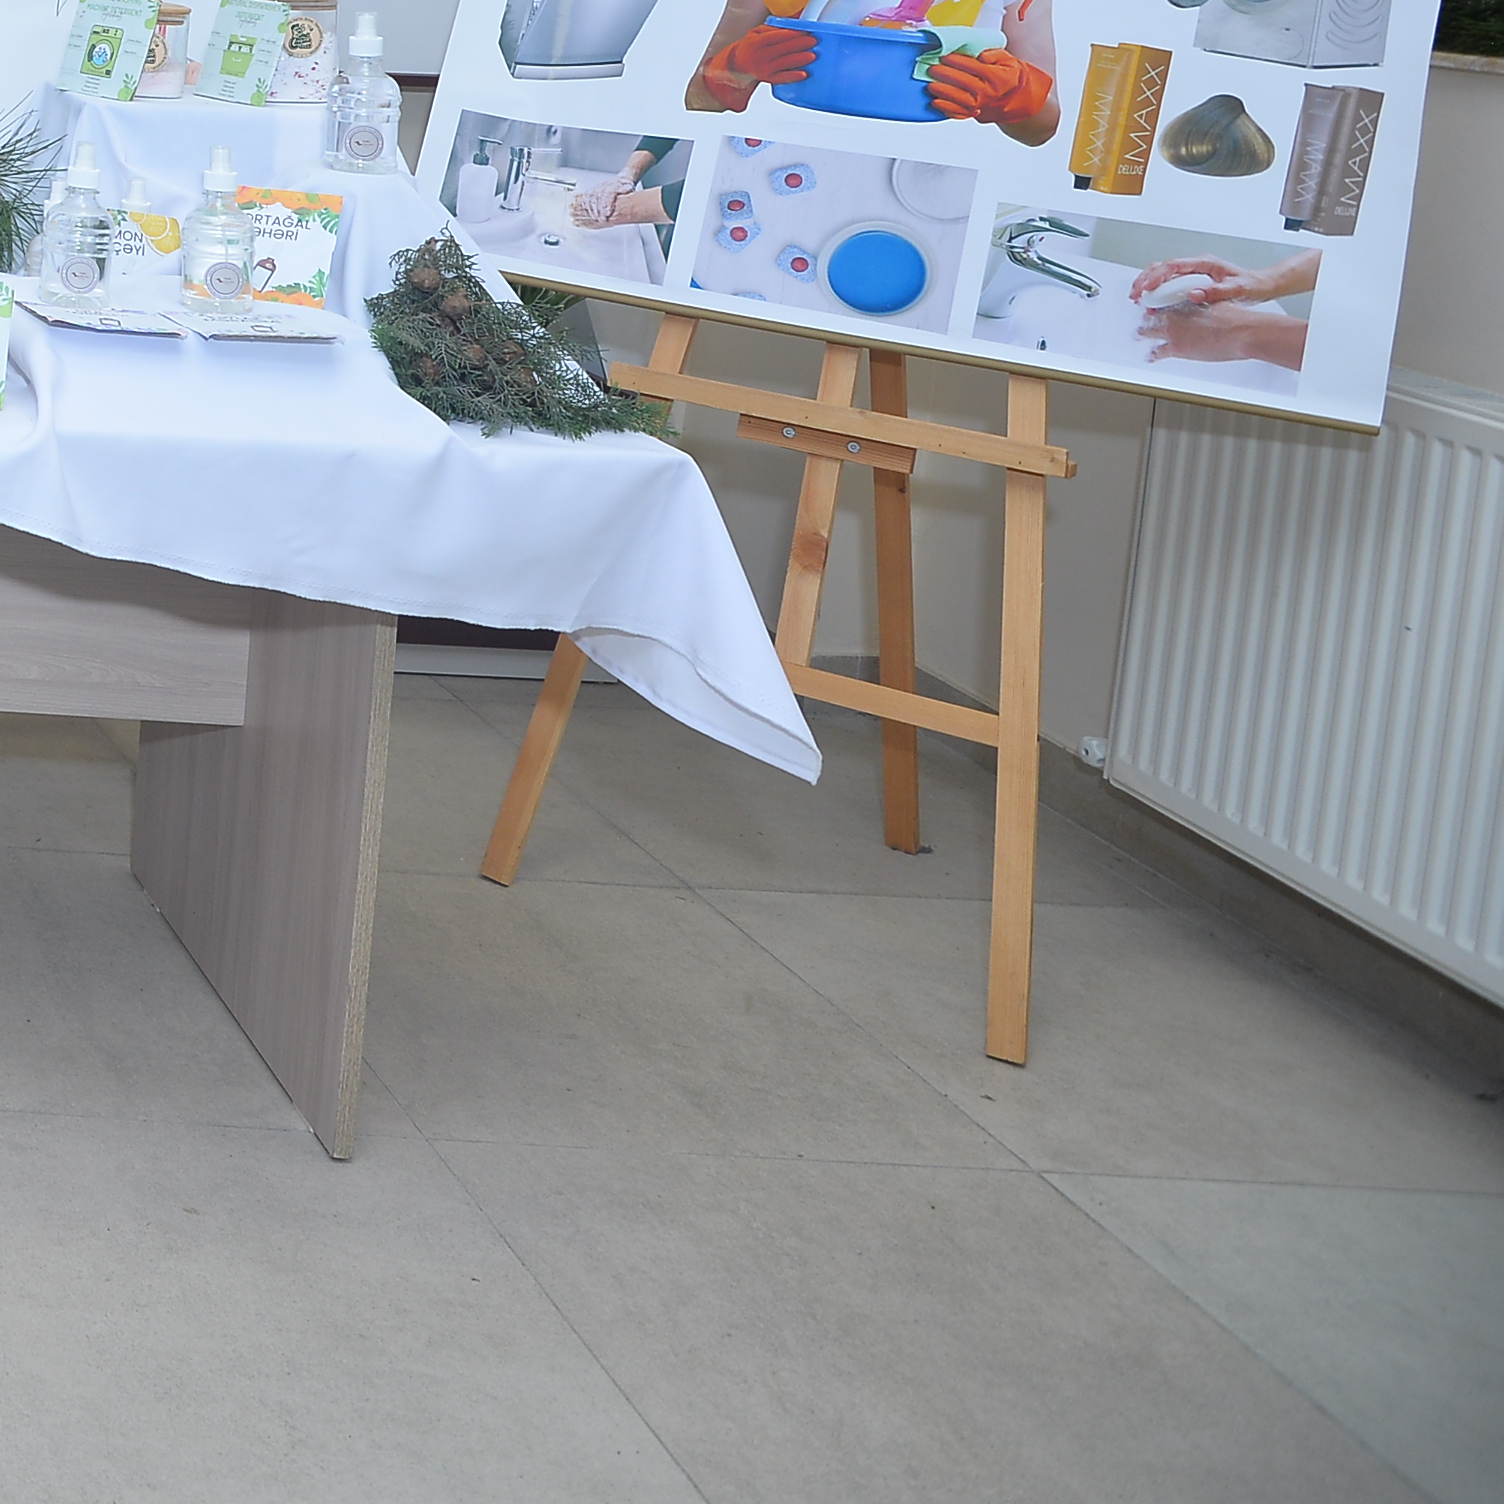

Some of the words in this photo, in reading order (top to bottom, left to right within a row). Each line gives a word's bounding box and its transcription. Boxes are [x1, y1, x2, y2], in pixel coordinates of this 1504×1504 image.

[1123, 62, 1165, 163] MAXX
[1118, 164, 1145, 176] DELUXE
[1340, 109, 1377, 205] MAXX
[246, 211, 311, 231] ORTAĞAL
